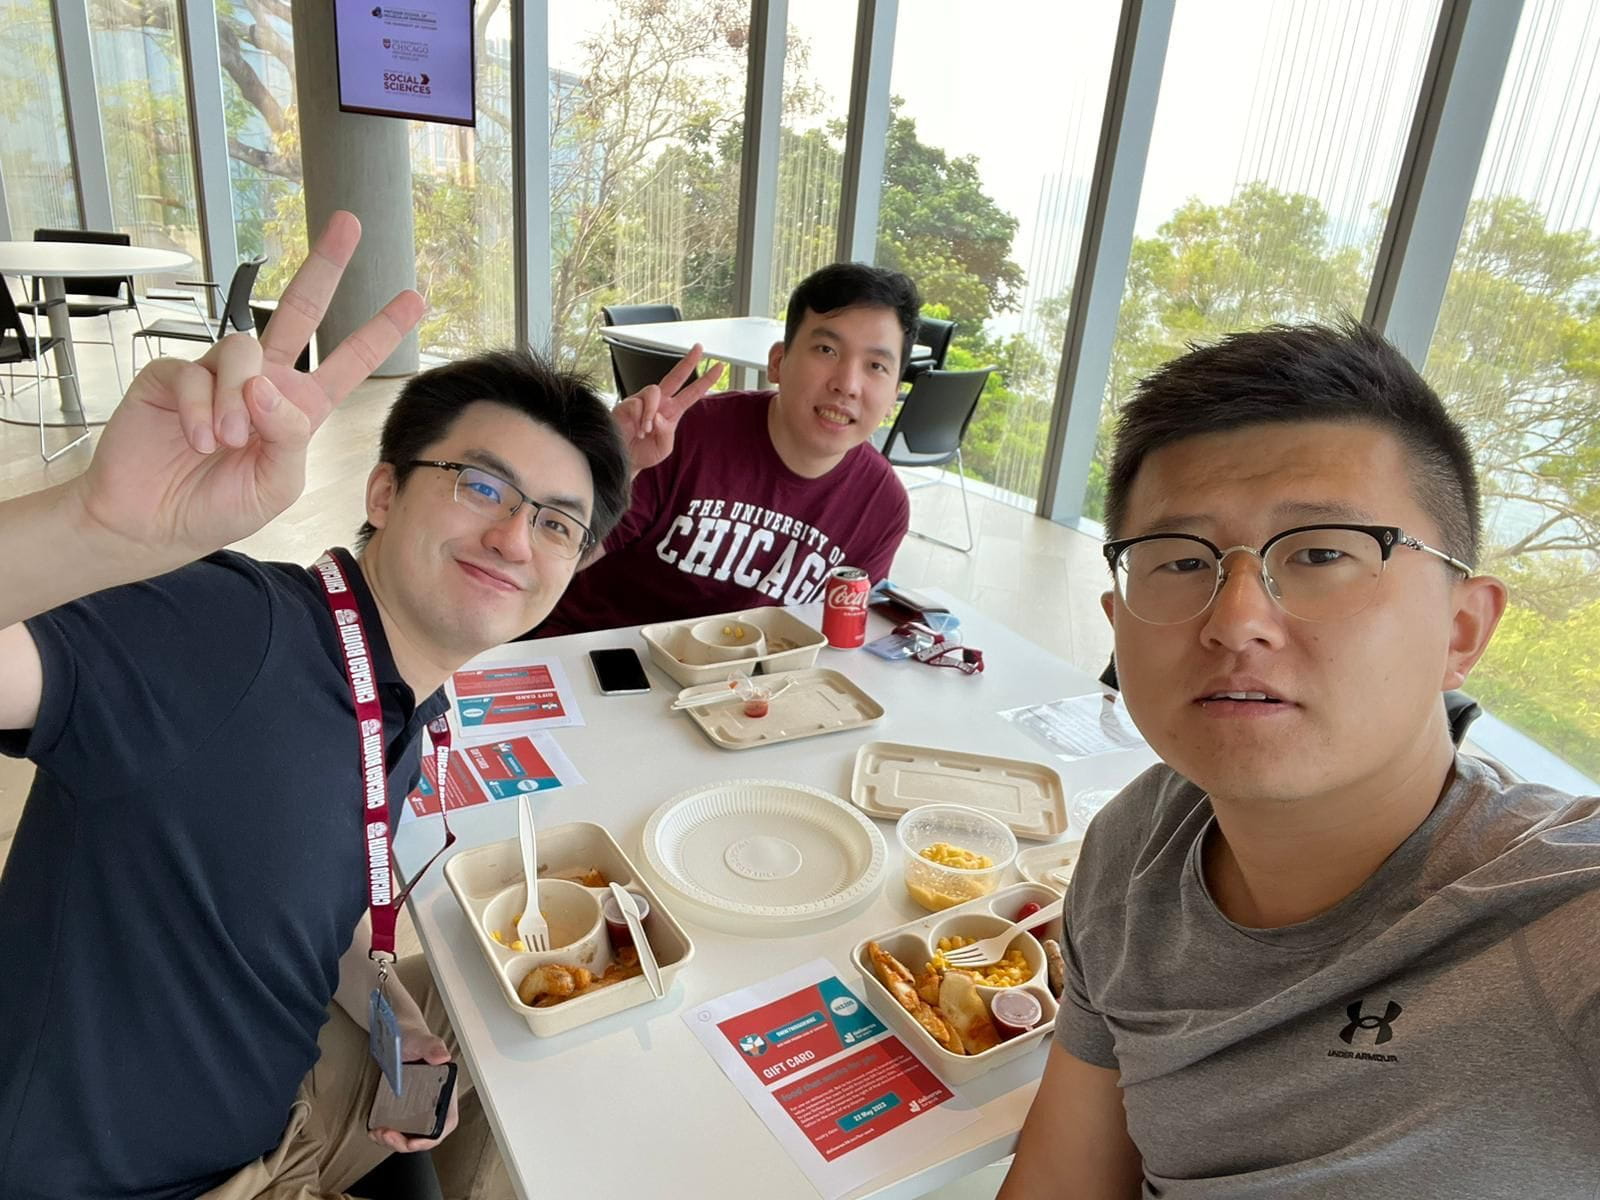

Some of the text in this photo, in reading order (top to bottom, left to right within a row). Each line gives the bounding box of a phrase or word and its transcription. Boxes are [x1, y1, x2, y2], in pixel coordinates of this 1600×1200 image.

[384, 73, 419, 84] SOCIAL
[384, 82, 431, 95] SCIENCES
[687, 499, 725, 517] THE
[730, 501, 829, 552] UNIVERSITY
[656, 515, 830, 606] CHICAG
[340, 623, 376, 703] CHICAGO BOOTH
[363, 733, 386, 809] CHICAGO BOOTH
[437, 745, 450, 785] CHICAGO
[368, 836, 391, 906] CHICAGO BOOTH
[763, 1062, 787, 1078] GIFT
[785, 1050, 815, 1068] CARD
[1327, 1050, 1398, 1062] UNDER ARMOUR
[860, 1108, 875, 1119] May
